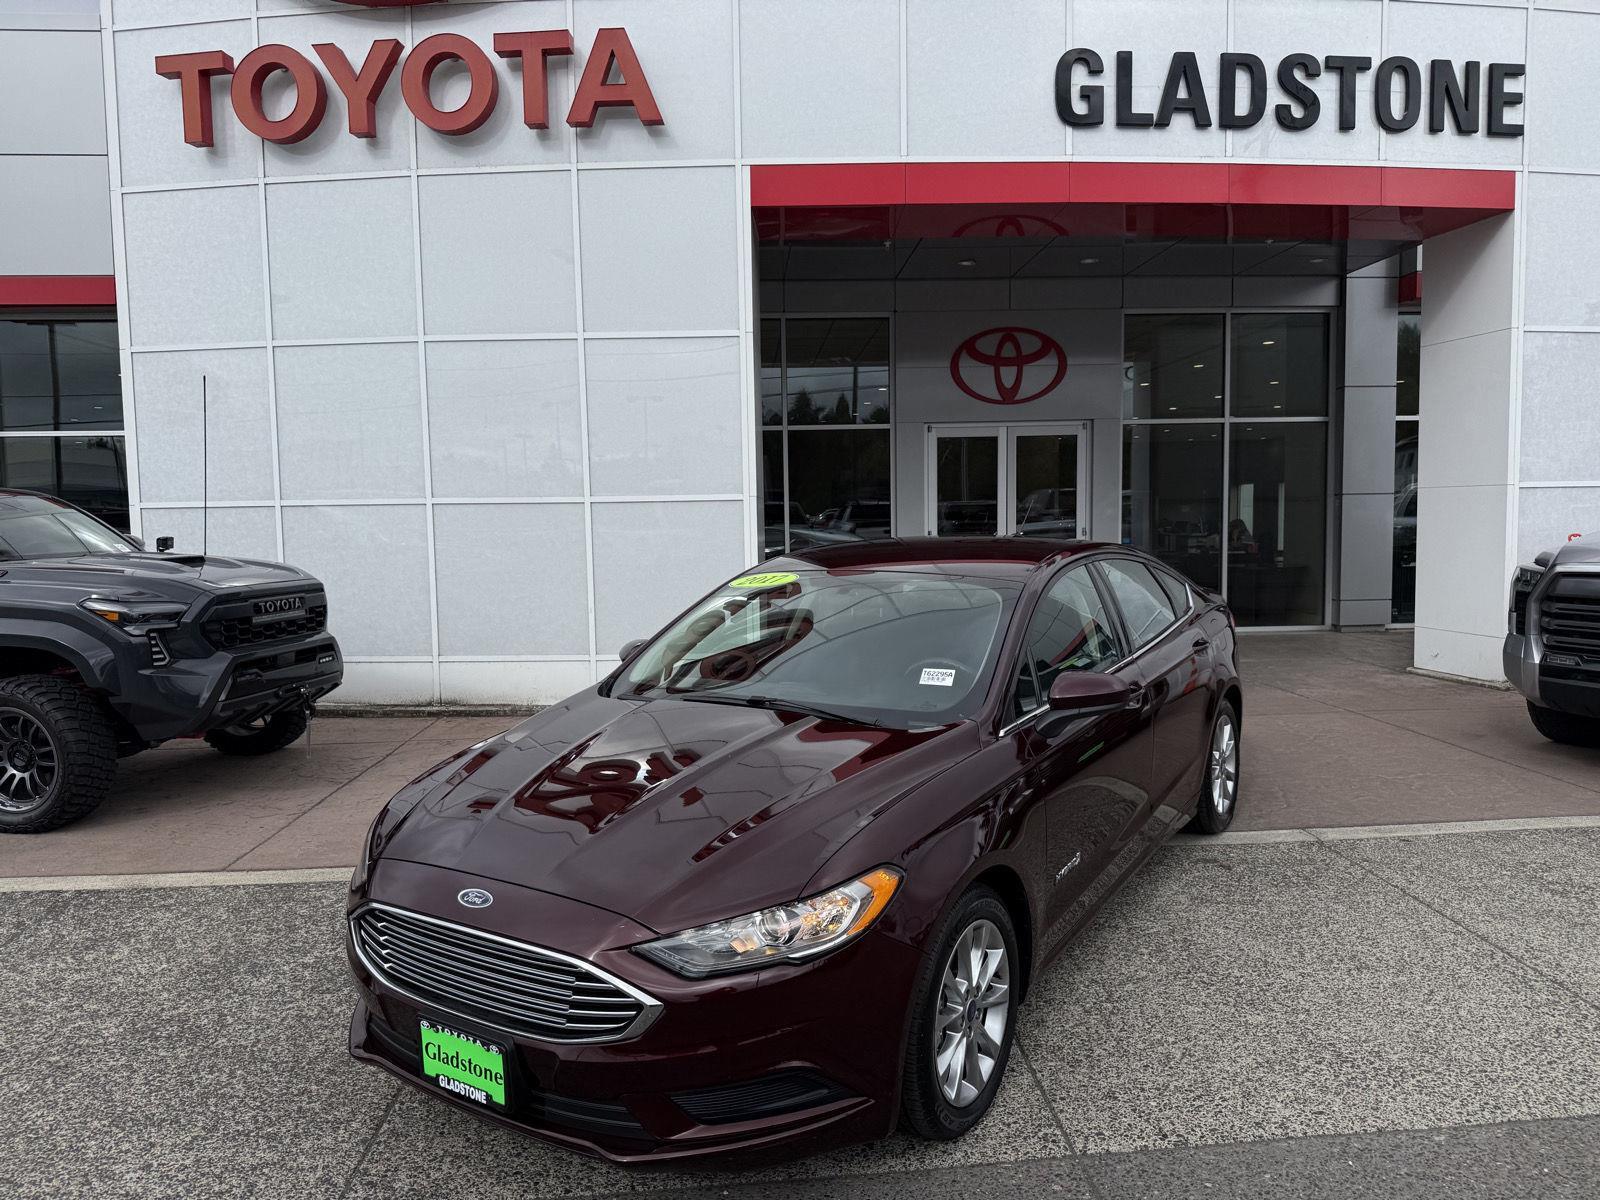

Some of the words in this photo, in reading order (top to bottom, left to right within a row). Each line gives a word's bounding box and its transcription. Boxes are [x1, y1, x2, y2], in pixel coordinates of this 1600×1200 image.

[155, 27, 664, 148] TOYOTA
[1054, 48, 1526, 137] GLADSTONE
[258, 597, 303, 613] TOYOTA
[463, 891, 487, 904] Ford
[436, 1025, 483, 1048] TOYOTA
[424, 1041, 504, 1086] Gladstone
[438, 1074, 487, 1105] GLADSTONE
